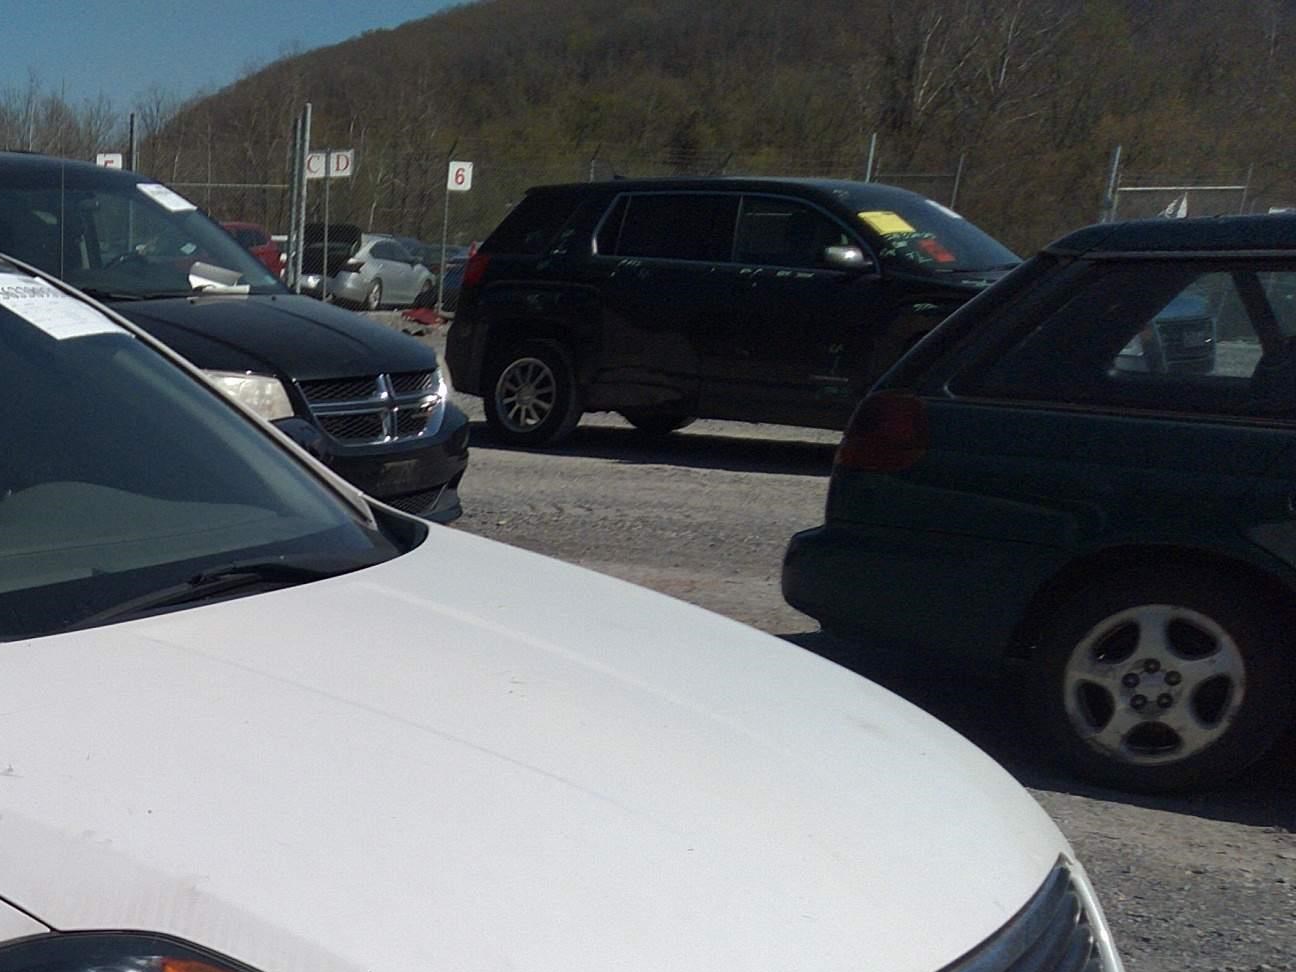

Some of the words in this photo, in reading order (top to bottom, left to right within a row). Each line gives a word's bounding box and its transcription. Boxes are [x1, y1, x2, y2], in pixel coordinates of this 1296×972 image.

[306, 154, 321, 174] C
[335, 153, 350, 172] D
[454, 167, 466, 186] 6
